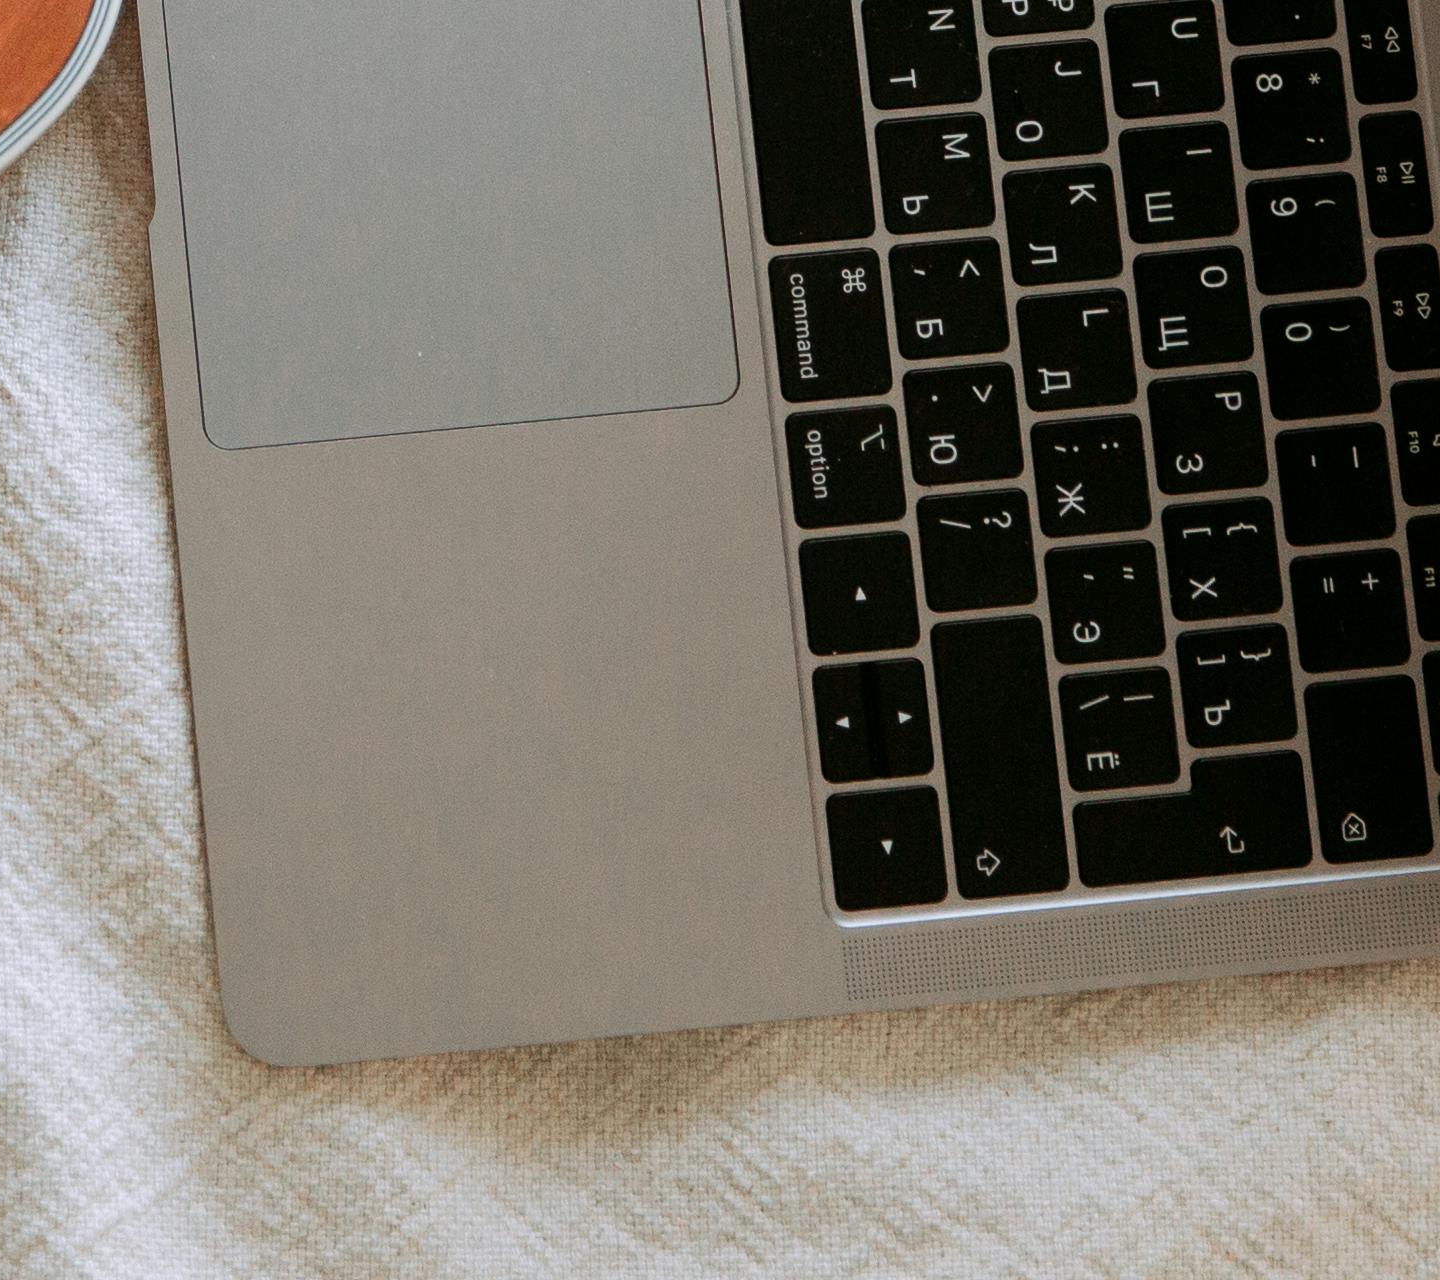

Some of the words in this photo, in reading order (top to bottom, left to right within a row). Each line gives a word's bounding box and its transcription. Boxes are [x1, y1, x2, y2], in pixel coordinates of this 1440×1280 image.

[927, 8, 956, 31] N
[1171, 16, 1199, 39] U
[1361, 34, 1372, 49] F7
[1054, 60, 1082, 77] J
[1131, 80, 1160, 98] Г
[1255, 73, 1283, 93] 8
[941, 132, 971, 160] M
[1376, 166, 1388, 183] F8
[902, 194, 930, 216] Ь
[1068, 183, 1097, 205] K
[1144, 191, 1175, 223] Ш
[1270, 197, 1298, 217] 9
[1028, 242, 1058, 265] Л
[1082, 308, 1110, 328] L
[1392, 300, 1404, 317] F9
[789, 273, 819, 379] command
[915, 318, 944, 339] Б
[1158, 315, 1189, 352] Щ
[1037, 367, 1072, 395] Д
[1214, 391, 1242, 411] P
[928, 434, 958, 465] Ю
[1408, 430, 1420, 454] F10
[804, 429, 830, 499] option
[1055, 482, 1086, 518] Ж
[1424, 567, 1436, 587] F11
[1072, 620, 1101, 643] Э
[1204, 699, 1231, 726] Ъ
[1086, 751, 1121, 772] Ё
